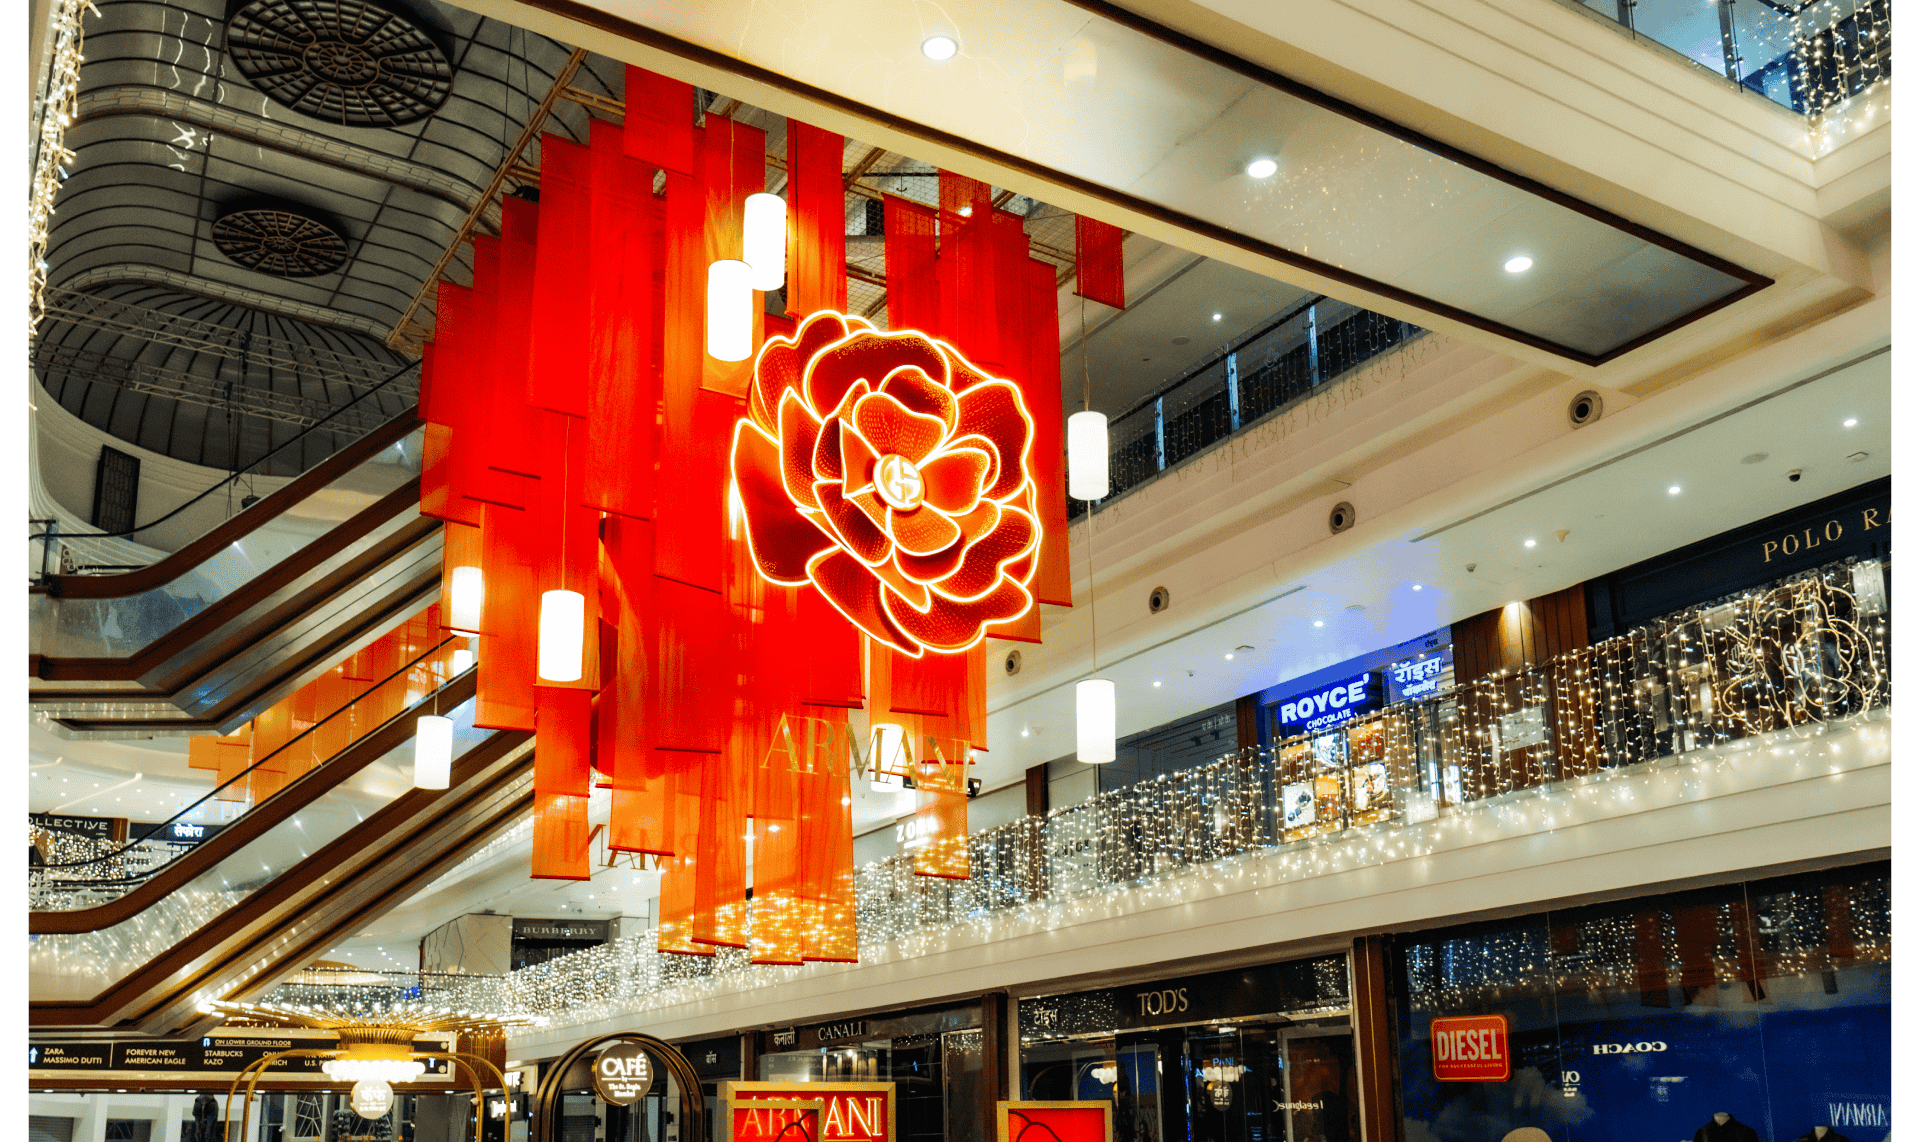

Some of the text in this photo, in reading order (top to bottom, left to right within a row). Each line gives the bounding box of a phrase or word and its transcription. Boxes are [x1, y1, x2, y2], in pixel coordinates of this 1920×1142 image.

[1762, 520, 1843, 562] POLO
[1306, 708, 1351, 731] CHOCOLATE
[760, 711, 973, 795] ARMANI
[523, 926, 597, 935] BURBERRY
[1136, 987, 1189, 1017] TOD'S
[818, 1021, 863, 1041] CANALI
[44, 1047, 65, 1056] ZARA
[1437, 1028, 1502, 1061] DIESEL
[126, 1048, 157, 1056] FOREVER
[204, 1050, 244, 1058] STARBUCKS
[43, 1056, 102, 1065] MASSIMO DUTTI
[125, 1057, 186, 1065] AMERICAN EAGLE
[203, 1058, 224, 1066] KAZO
[601, 1052, 647, 1076] CAFÉ
